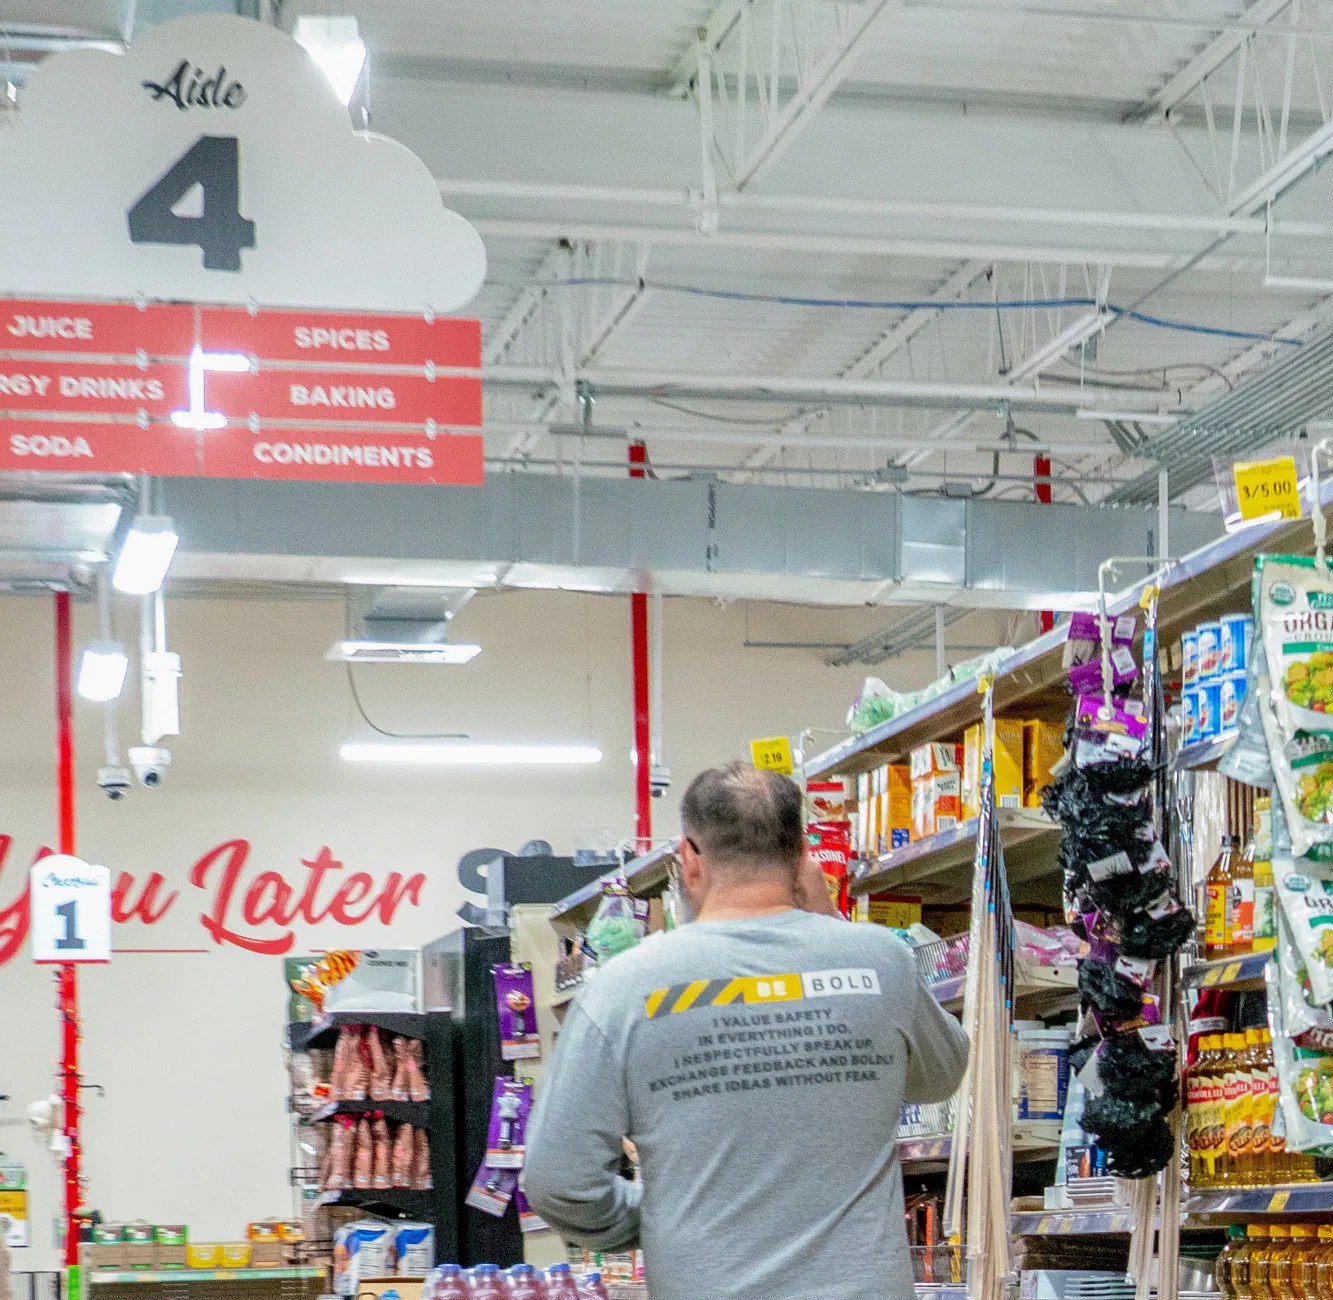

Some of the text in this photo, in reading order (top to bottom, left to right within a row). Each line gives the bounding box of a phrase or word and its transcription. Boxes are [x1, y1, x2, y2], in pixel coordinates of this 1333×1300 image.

[143, 58, 247, 111] Aisle
[127, 134, 257, 273] 4
[7, 314, 93, 341] JUICE
[294, 326, 391, 352] SPICES
[59, 375, 165, 401] DRINKS
[289, 384, 396, 410] BAKING
[10, 434, 94, 459] SODA
[253, 442, 434, 469] CONDIMENTS
[189, 839, 426, 955] Later
[54, 898, 86, 950] 1
[756, 974, 874, 998] BE BOLD
[721, 1013, 771, 1027] VALUE
[775, 1007, 832, 1023] SAFETY
[698, 1034, 713, 1046] IN
[717, 1025, 814, 1045] EVERYTHING
[682, 1042, 799, 1067] RESPECTFULLY
[804, 1039, 852, 1052] SPEAK
[648, 1065, 728, 1092] EXCHANGE
[733, 1057, 817, 1076] FEEDBACK
[819, 1055, 848, 1068] AND
[673, 1081, 721, 1101] SHARE
[725, 1077, 772, 1093] IDEAS
[774, 1071, 842, 1087] WITHOUT
